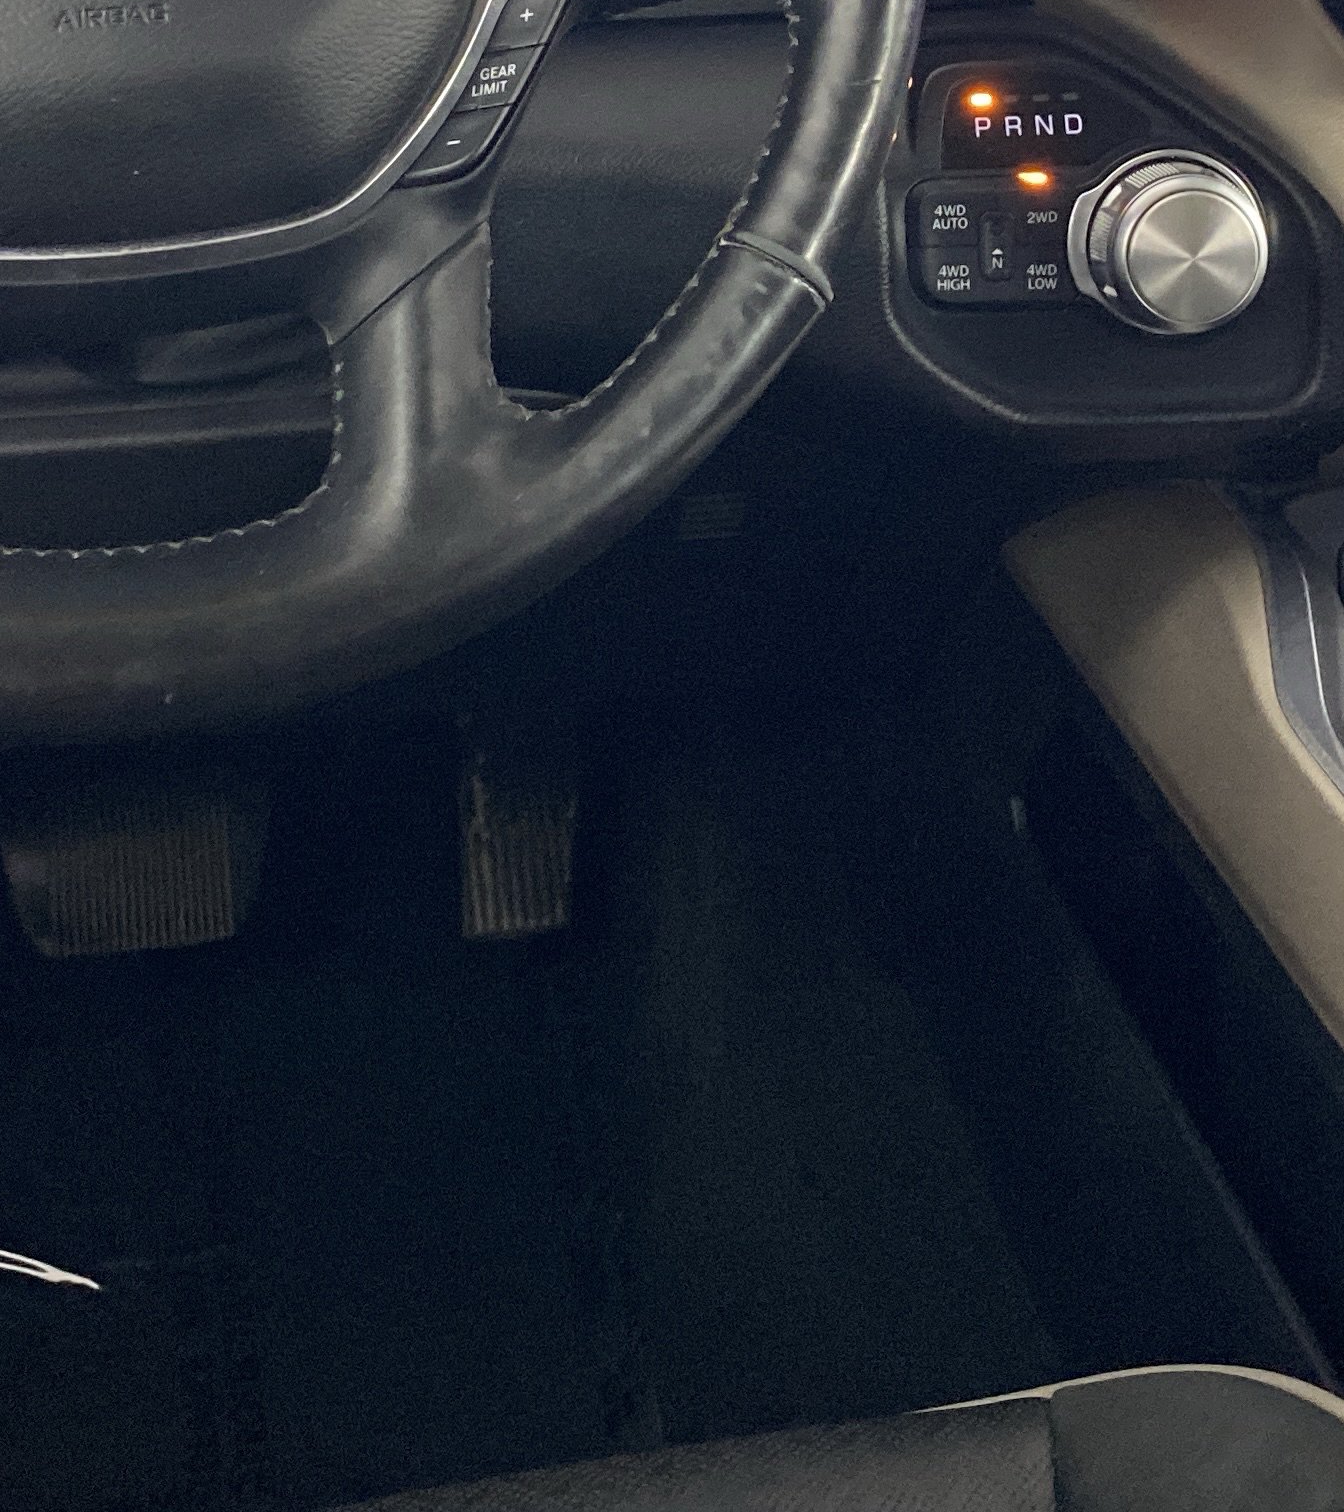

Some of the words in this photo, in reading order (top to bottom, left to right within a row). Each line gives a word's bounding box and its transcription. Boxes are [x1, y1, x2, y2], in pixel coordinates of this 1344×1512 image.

[54, 3, 170, 32] AIRBAG
[479, 63, 517, 81] GEAR
[471, 79, 508, 97] LIMIT
[974, 117, 992, 138] P
[1004, 115, 1023, 137] R
[1034, 114, 1054, 136] N
[1064, 113, 1084, 135] D
[934, 204, 966, 217] 4WD
[932, 217, 969, 231] AUTO
[1026, 211, 1057, 224] 2WD
[991, 256, 1003, 270] N
[938, 265, 970, 277] 4WD
[1026, 264, 1057, 276] 4WD
[937, 278, 971, 291] HIGH
[1027, 277, 1057, 290] LOW
